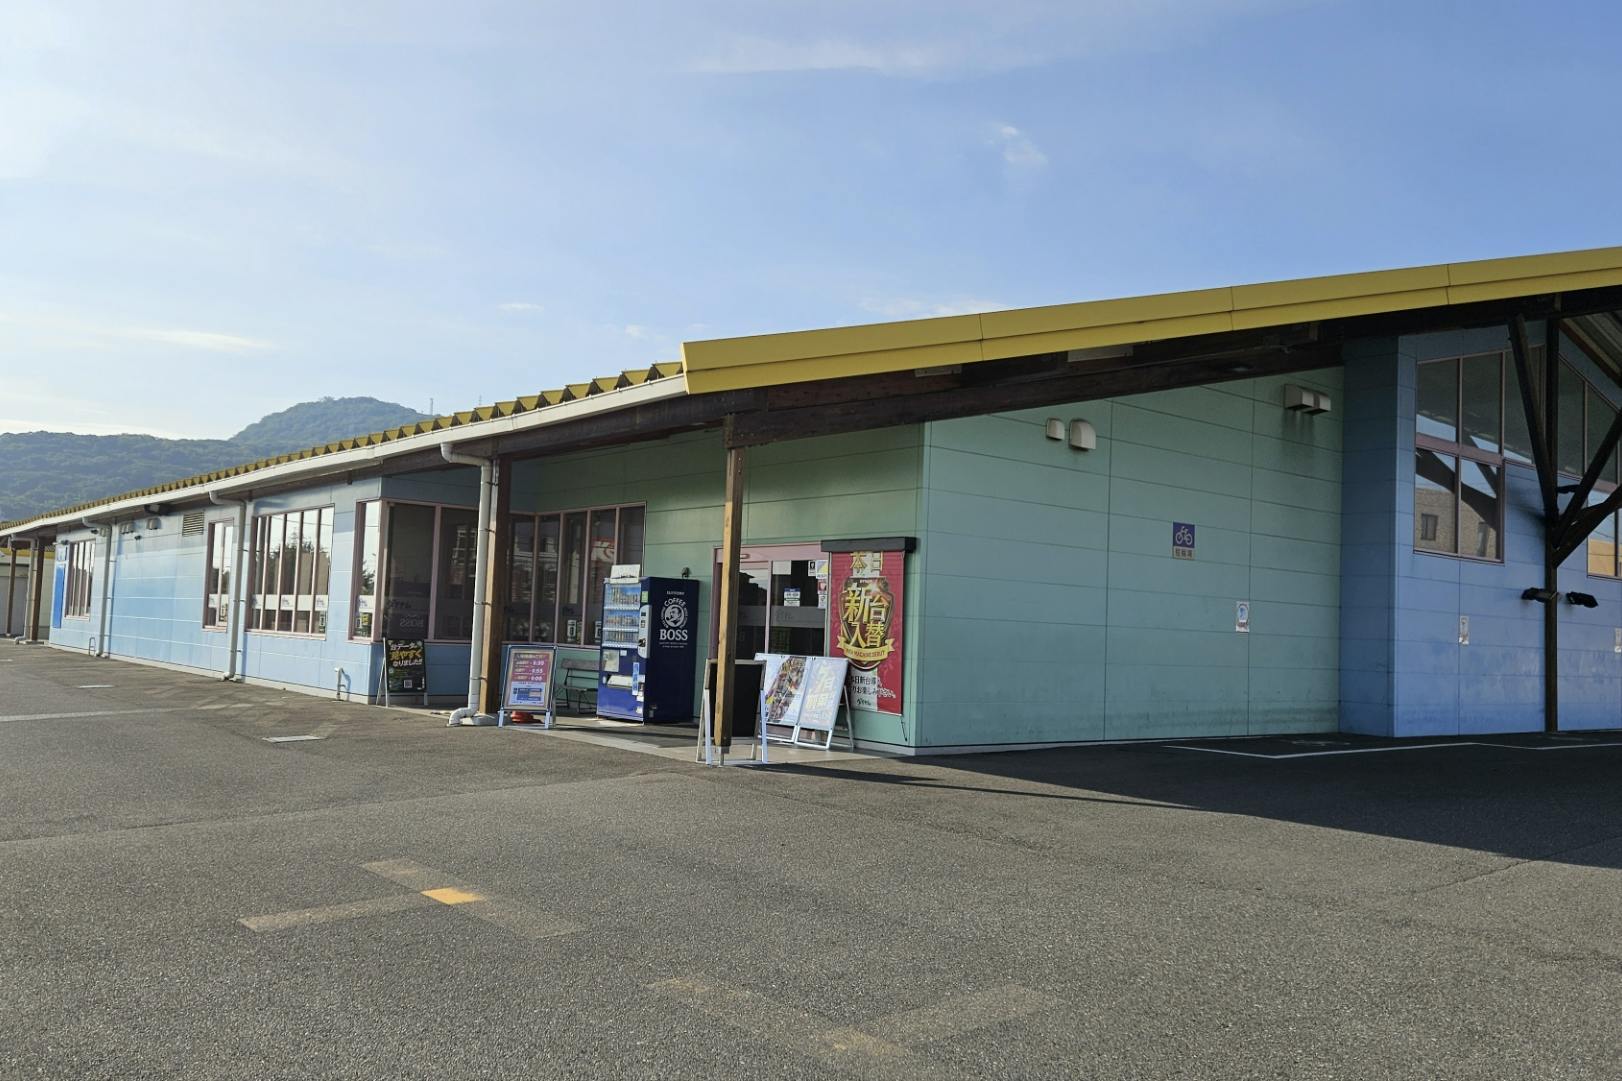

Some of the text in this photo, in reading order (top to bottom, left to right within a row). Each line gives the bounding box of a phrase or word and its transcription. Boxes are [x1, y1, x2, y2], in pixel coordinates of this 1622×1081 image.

[850, 551, 883, 573] 本日
[664, 597, 686, 607] COFFEE
[842, 583, 889, 624] 新台
[659, 629, 688, 641] BOSS
[849, 622, 884, 648] 入替
